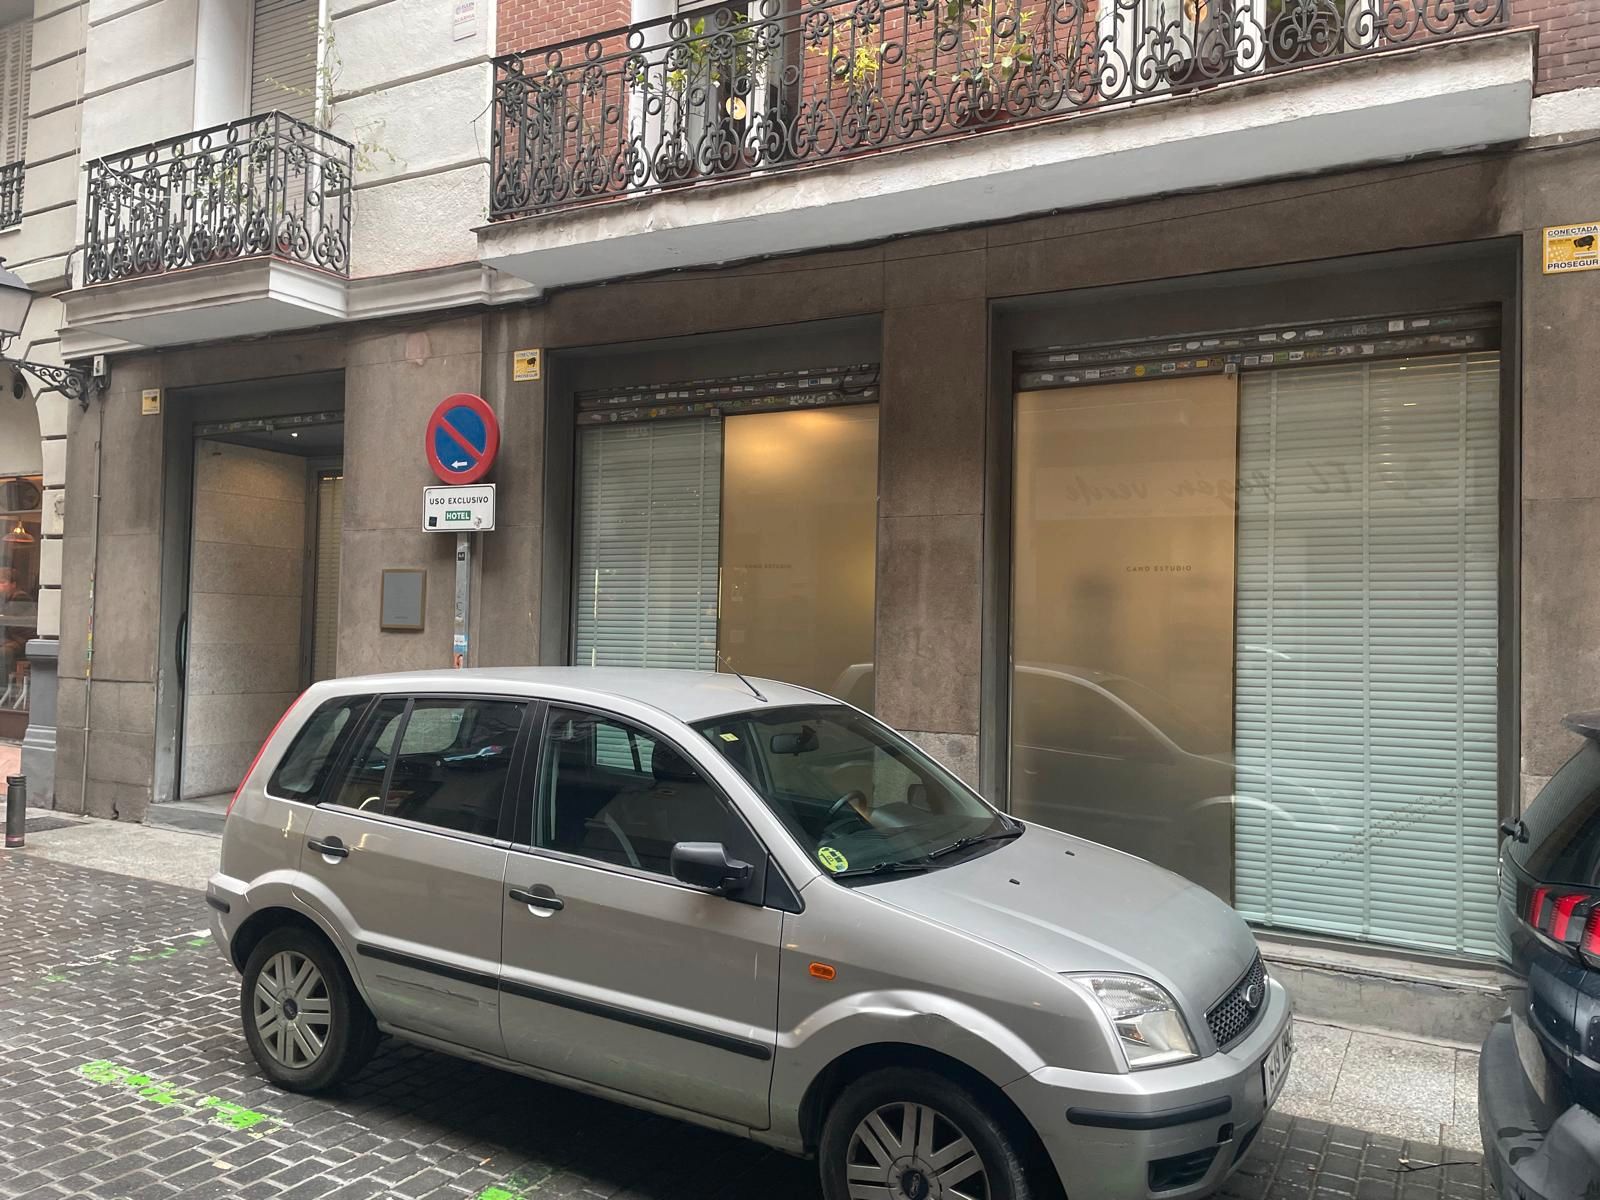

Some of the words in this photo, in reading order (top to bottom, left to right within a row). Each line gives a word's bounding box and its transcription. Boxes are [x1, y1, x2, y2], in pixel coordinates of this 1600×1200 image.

[1547, 225, 1598, 236] CONECTADA
[1547, 259, 1599, 270] PROSEGUR
[448, 495, 489, 505] EXCLUSIVO
[446, 512, 470, 520] HOTEL
